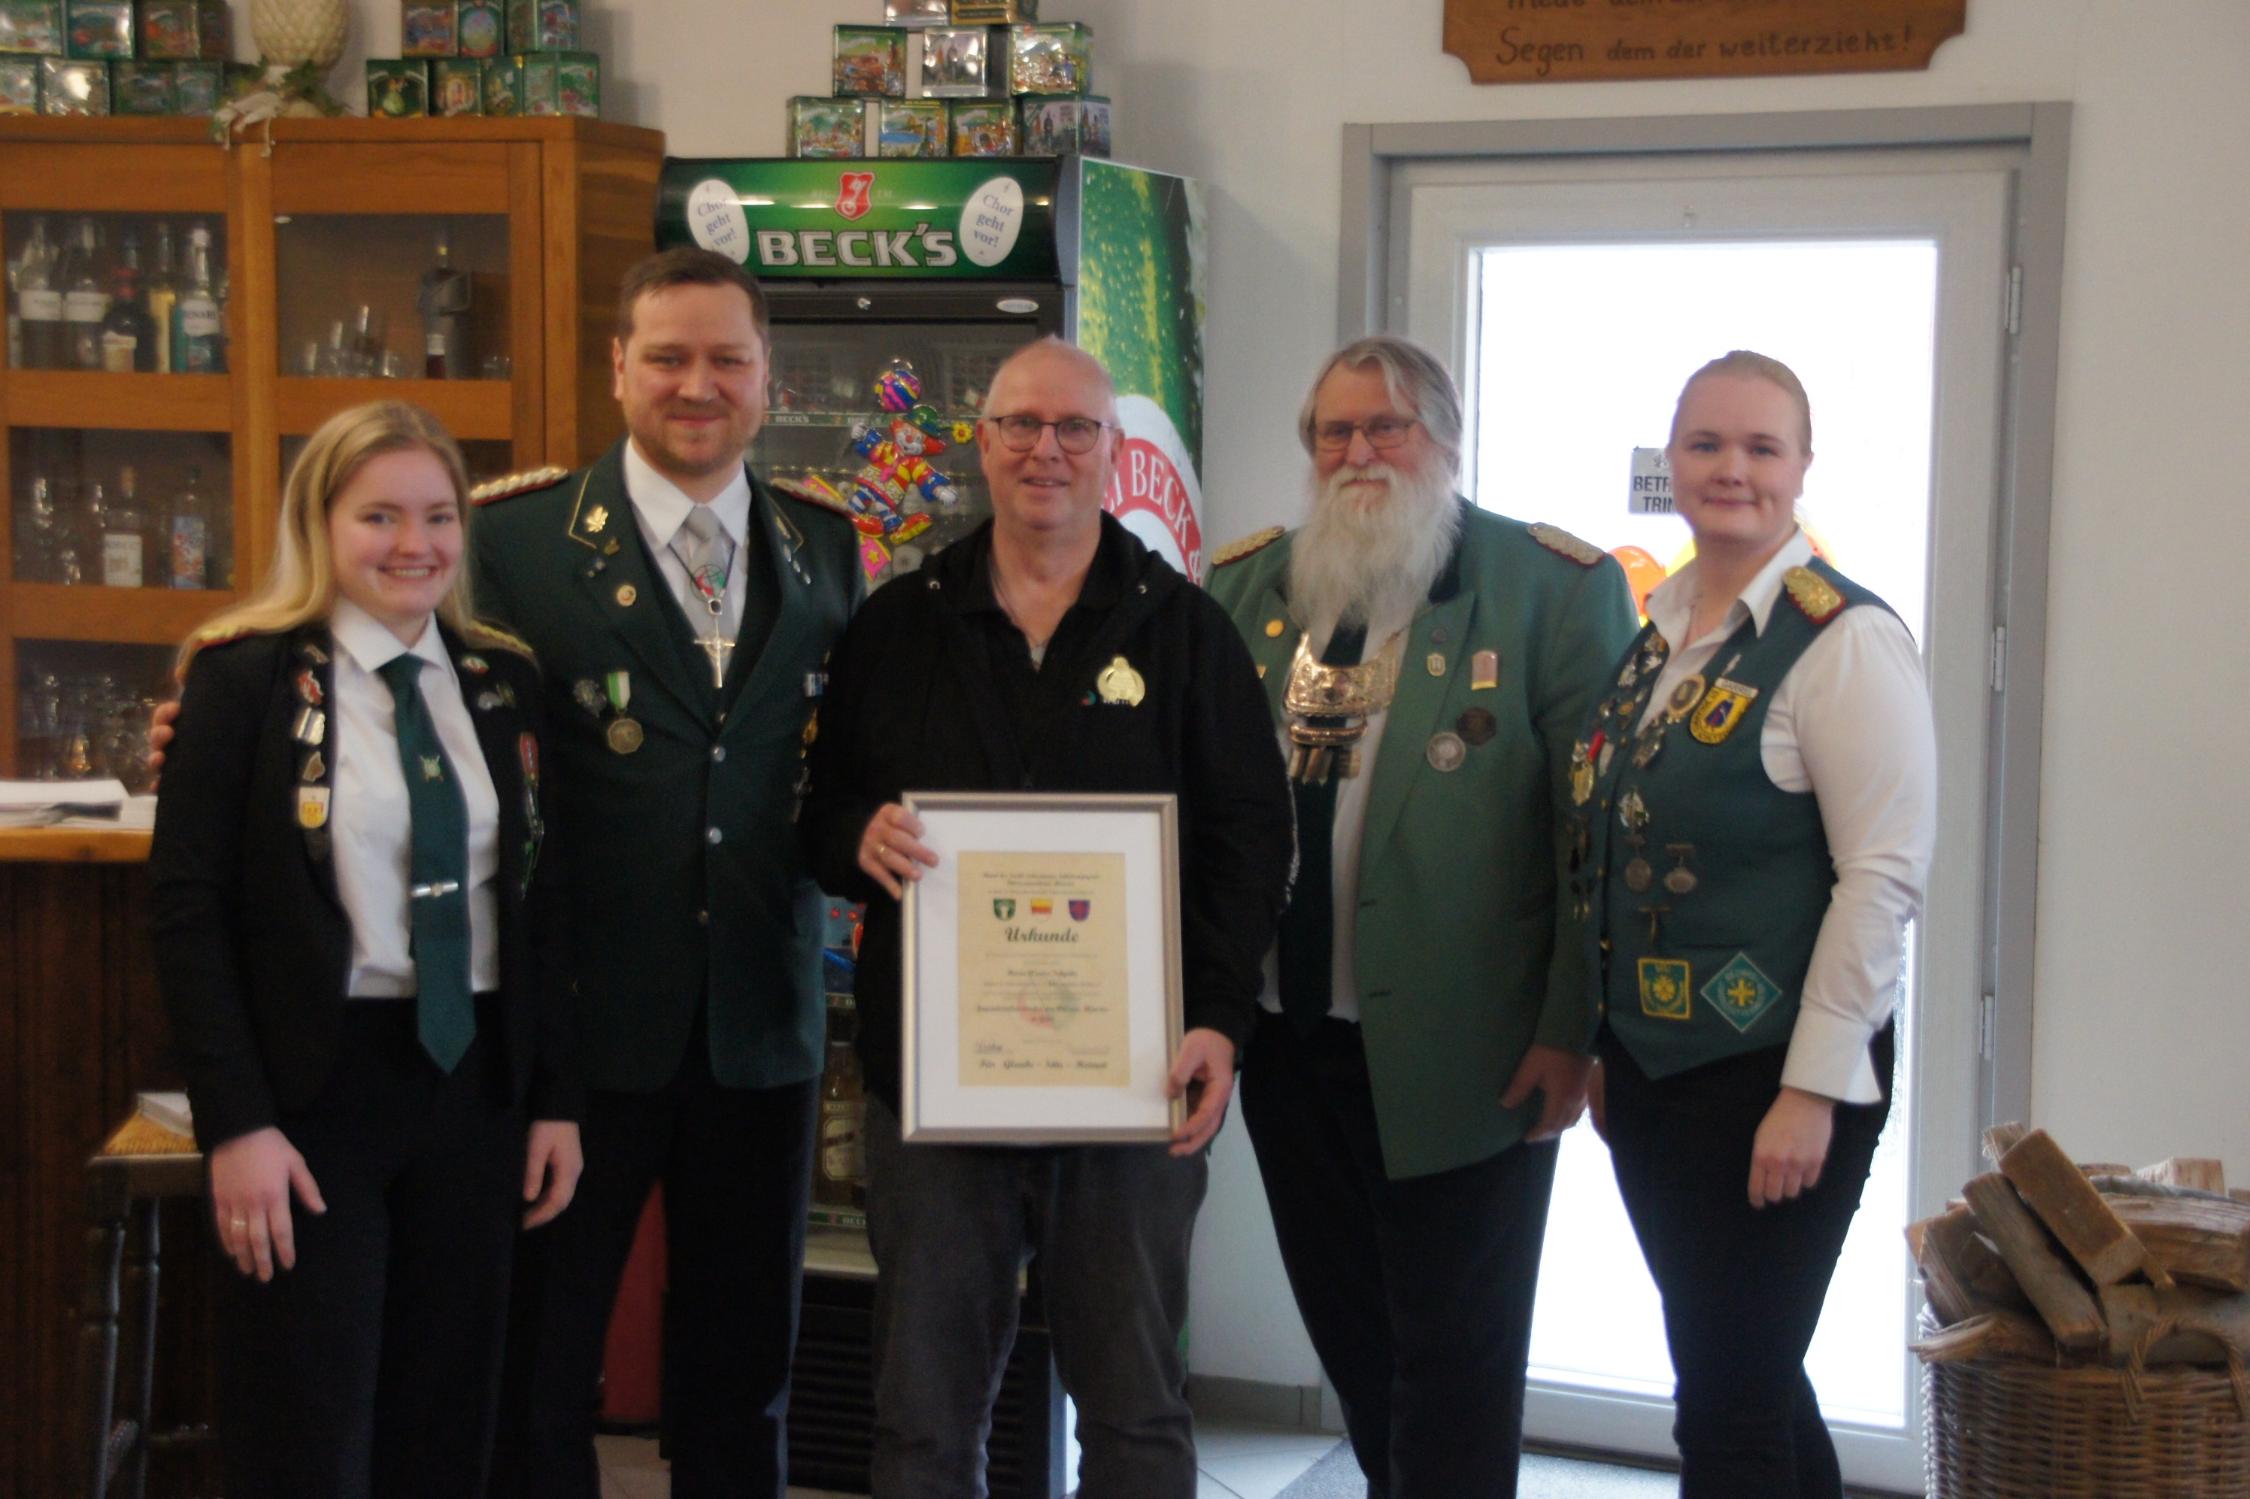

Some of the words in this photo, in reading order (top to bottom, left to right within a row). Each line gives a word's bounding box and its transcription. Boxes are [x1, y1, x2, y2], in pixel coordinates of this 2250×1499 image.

[1496, 26, 1584, 77] Segen
[1607, 39, 1655, 61] dem
[1667, 40, 1706, 60] der
[983, 193, 1014, 217] Chor
[706, 213, 731, 236] geht
[975, 211, 1005, 233] geht
[757, 223, 959, 267] BECK'S
[973, 230, 1000, 248] vor!
[1130, 449, 1193, 550] BECK
[1005, 927, 1079, 943] Urkunde
